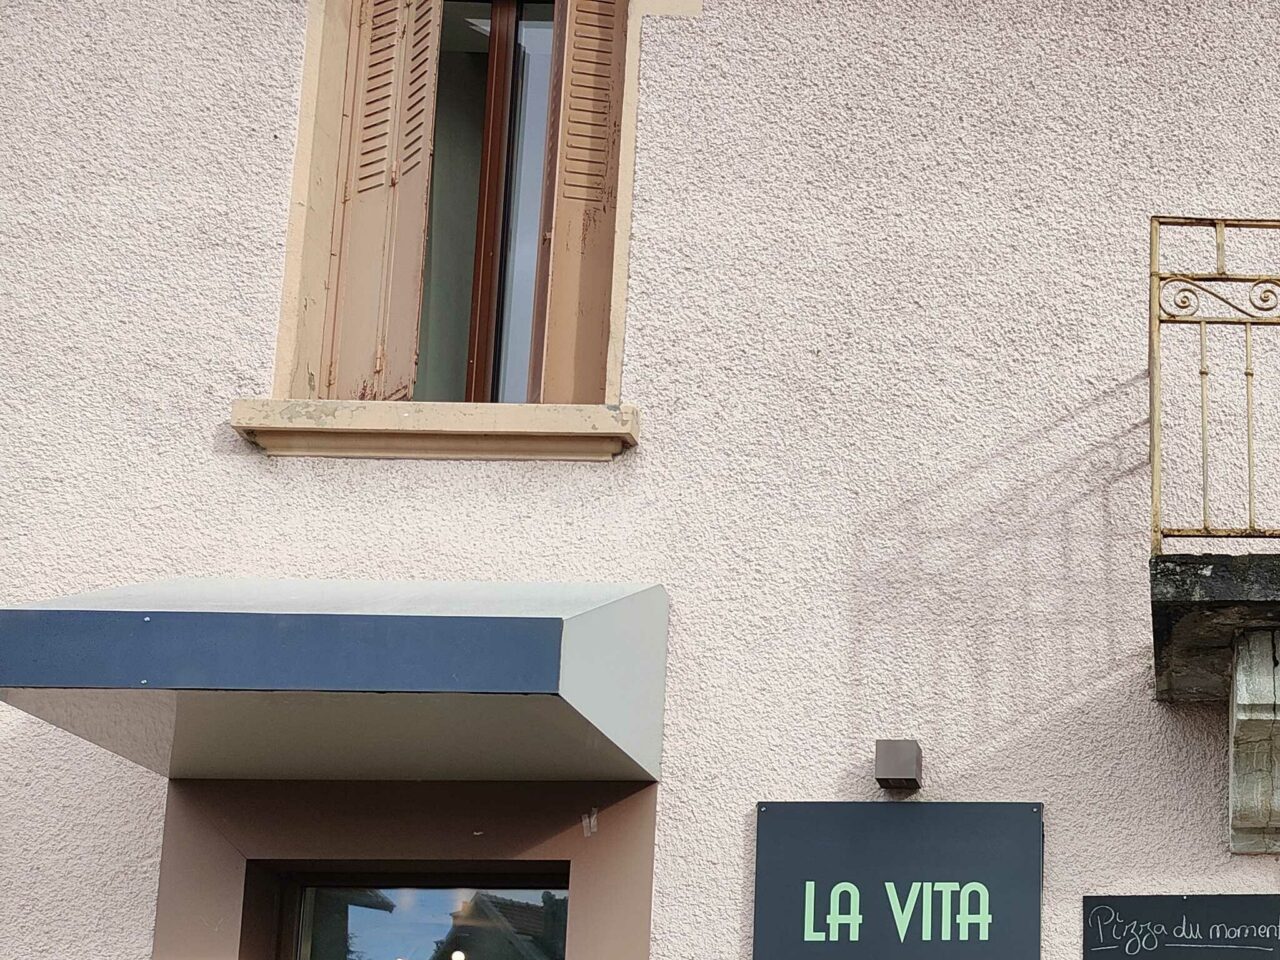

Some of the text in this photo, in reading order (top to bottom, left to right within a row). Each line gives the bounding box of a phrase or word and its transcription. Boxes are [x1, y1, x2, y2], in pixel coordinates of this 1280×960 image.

[804, 880, 992, 943] LA VITA
[1089, 905, 1168, 955] Pizza
[1173, 914, 1203, 940] du
